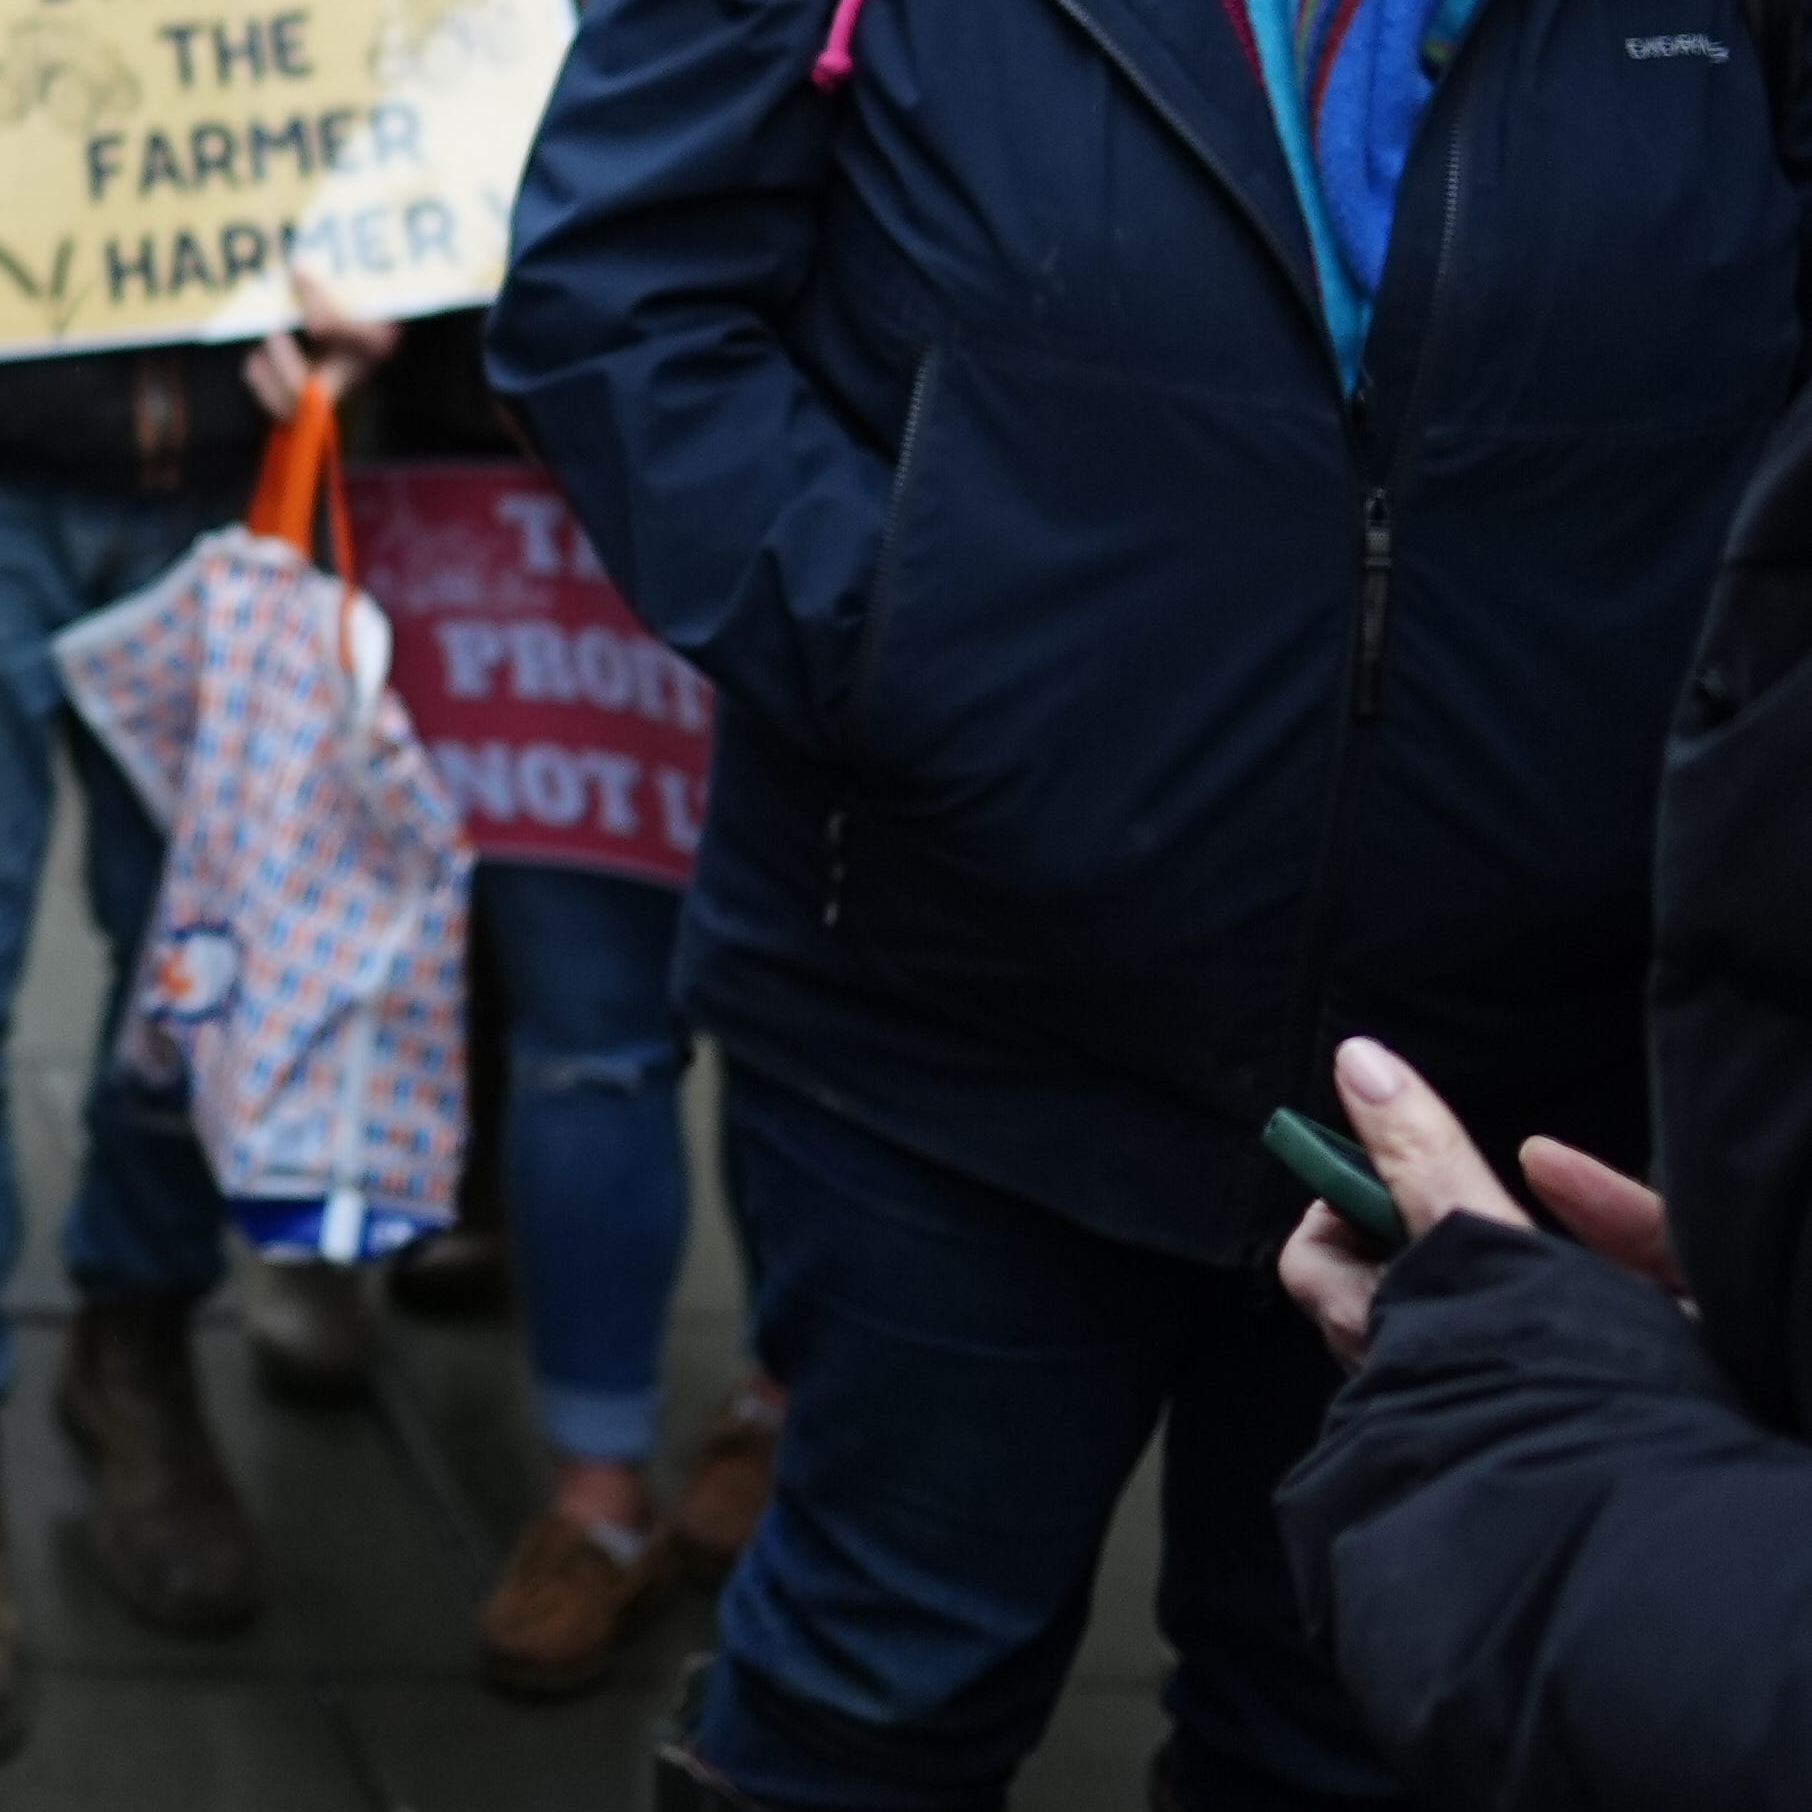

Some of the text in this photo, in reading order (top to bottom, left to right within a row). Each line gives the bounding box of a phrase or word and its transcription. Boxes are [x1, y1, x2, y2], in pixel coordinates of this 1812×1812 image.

[162, 13, 314, 88] THE
[85, 103, 421, 203] FARMER
[104, 202, 454, 304] HARMER
[433, 738, 640, 838] NOT
